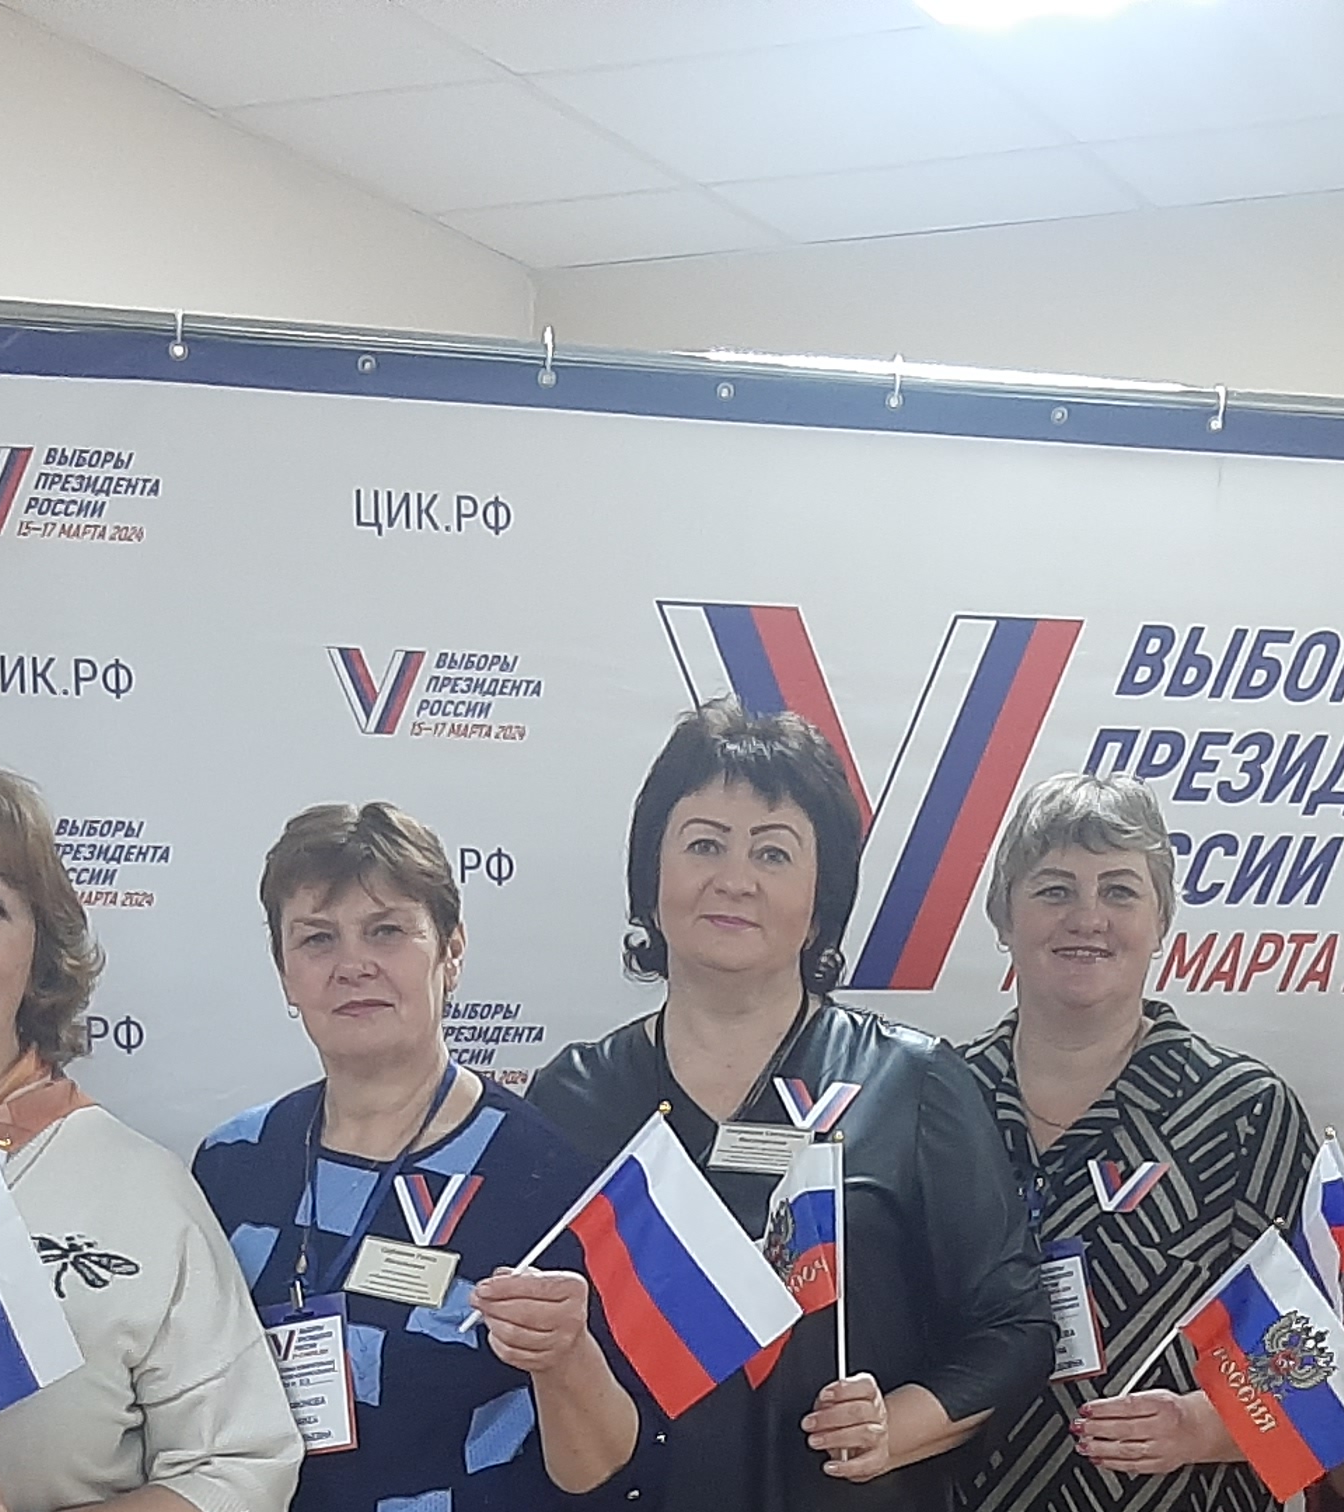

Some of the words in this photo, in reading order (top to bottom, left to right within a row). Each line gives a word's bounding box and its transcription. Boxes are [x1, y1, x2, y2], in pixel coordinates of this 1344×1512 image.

[44, 447, 134, 469] ВЫБОРЫ
[35, 473, 160, 497] ПРЕЗИДЕНТА
[24, 498, 107, 518] РОССИИ
[355, 488, 512, 537] ЦИК.РФ
[435, 652, 518, 673] ВЫБОРЫ
[425, 676, 542, 697] ПРЕЗИДЕНТА
[416, 699, 493, 719] РОССИИ
[54, 818, 144, 838] ВЫБОРЫ
[1156, 931, 1340, 994] МАРТА
[443, 1026, 544, 1044] РЕЗИДЕНТА
[1213, 1347, 1277, 1433] РОССИЯ
